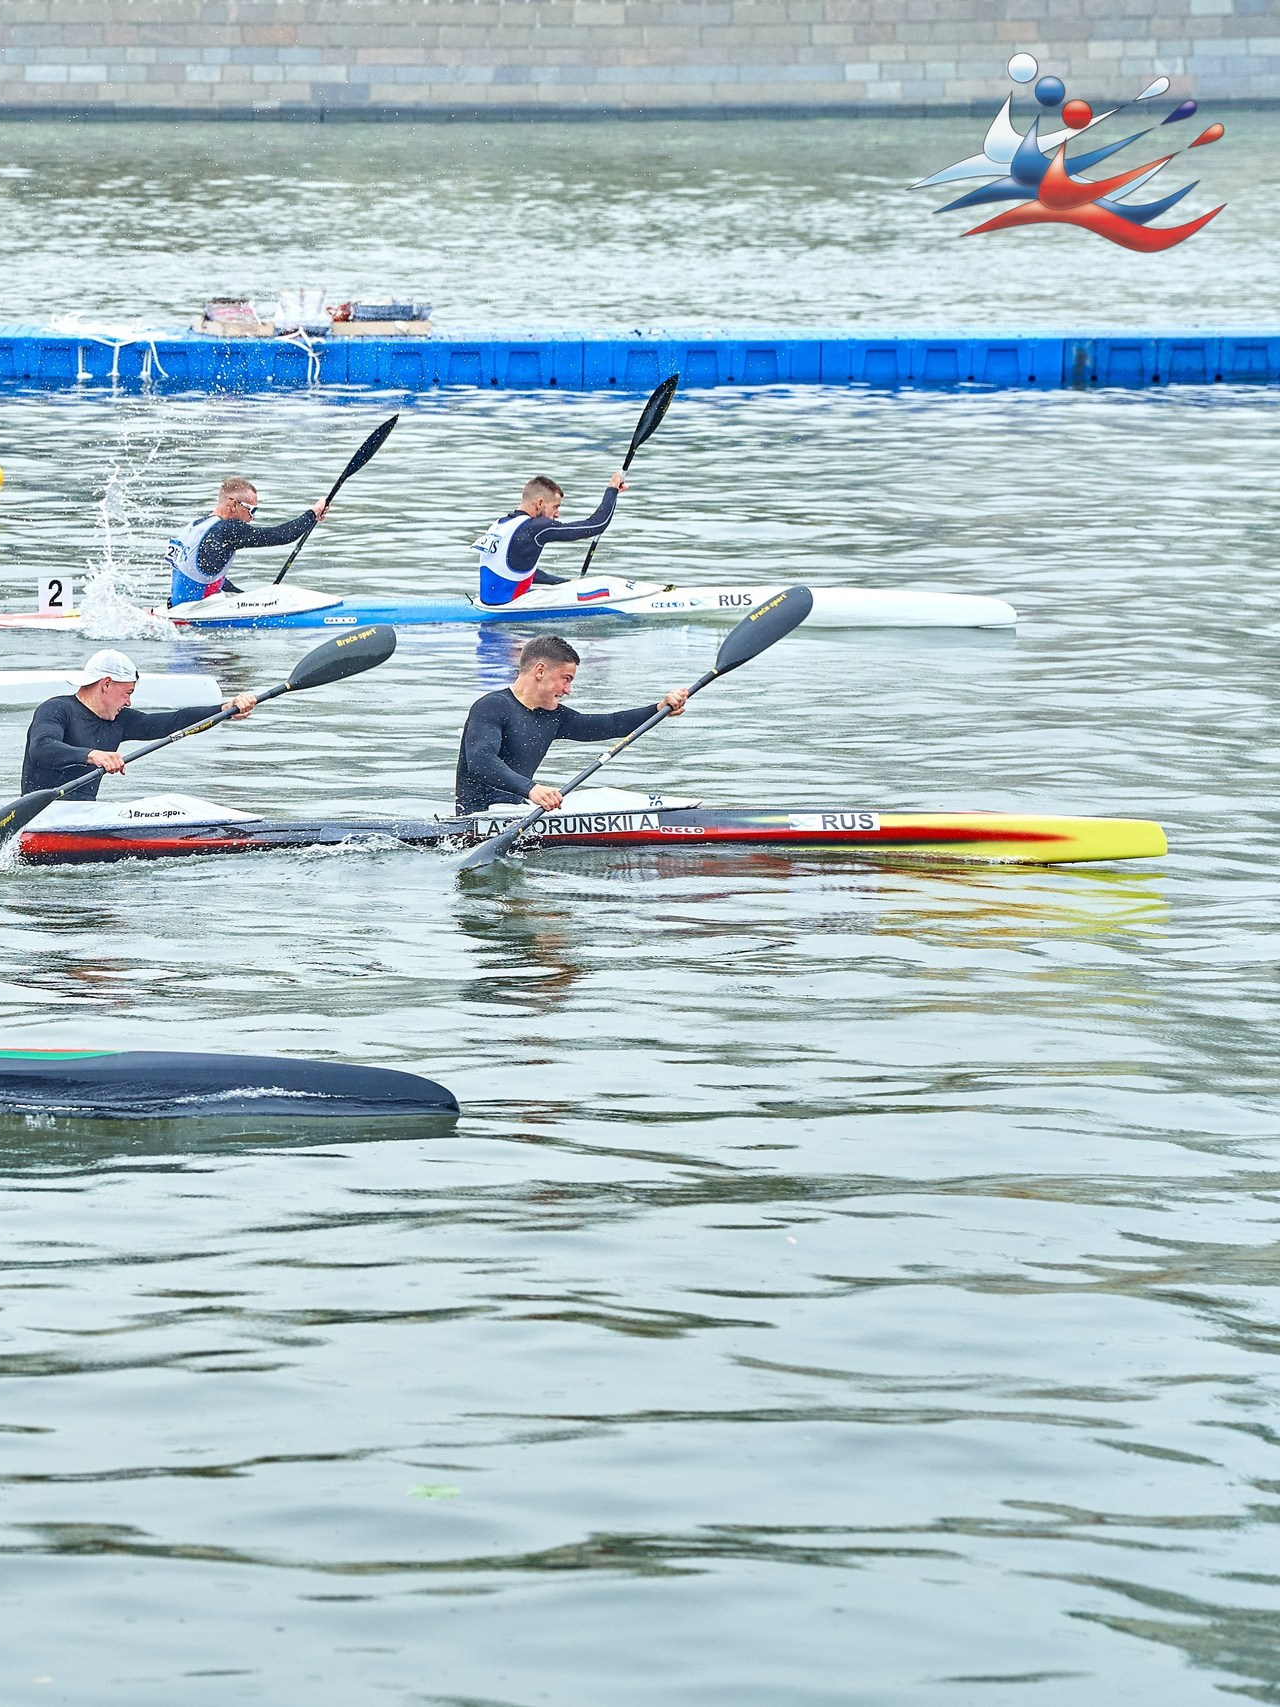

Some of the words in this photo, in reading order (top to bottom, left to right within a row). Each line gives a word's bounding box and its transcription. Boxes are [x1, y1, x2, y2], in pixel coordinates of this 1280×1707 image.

[49, 580, 63, 607] 2
[719, 593, 753, 607] RUS
[821, 814, 874, 830] RUS
